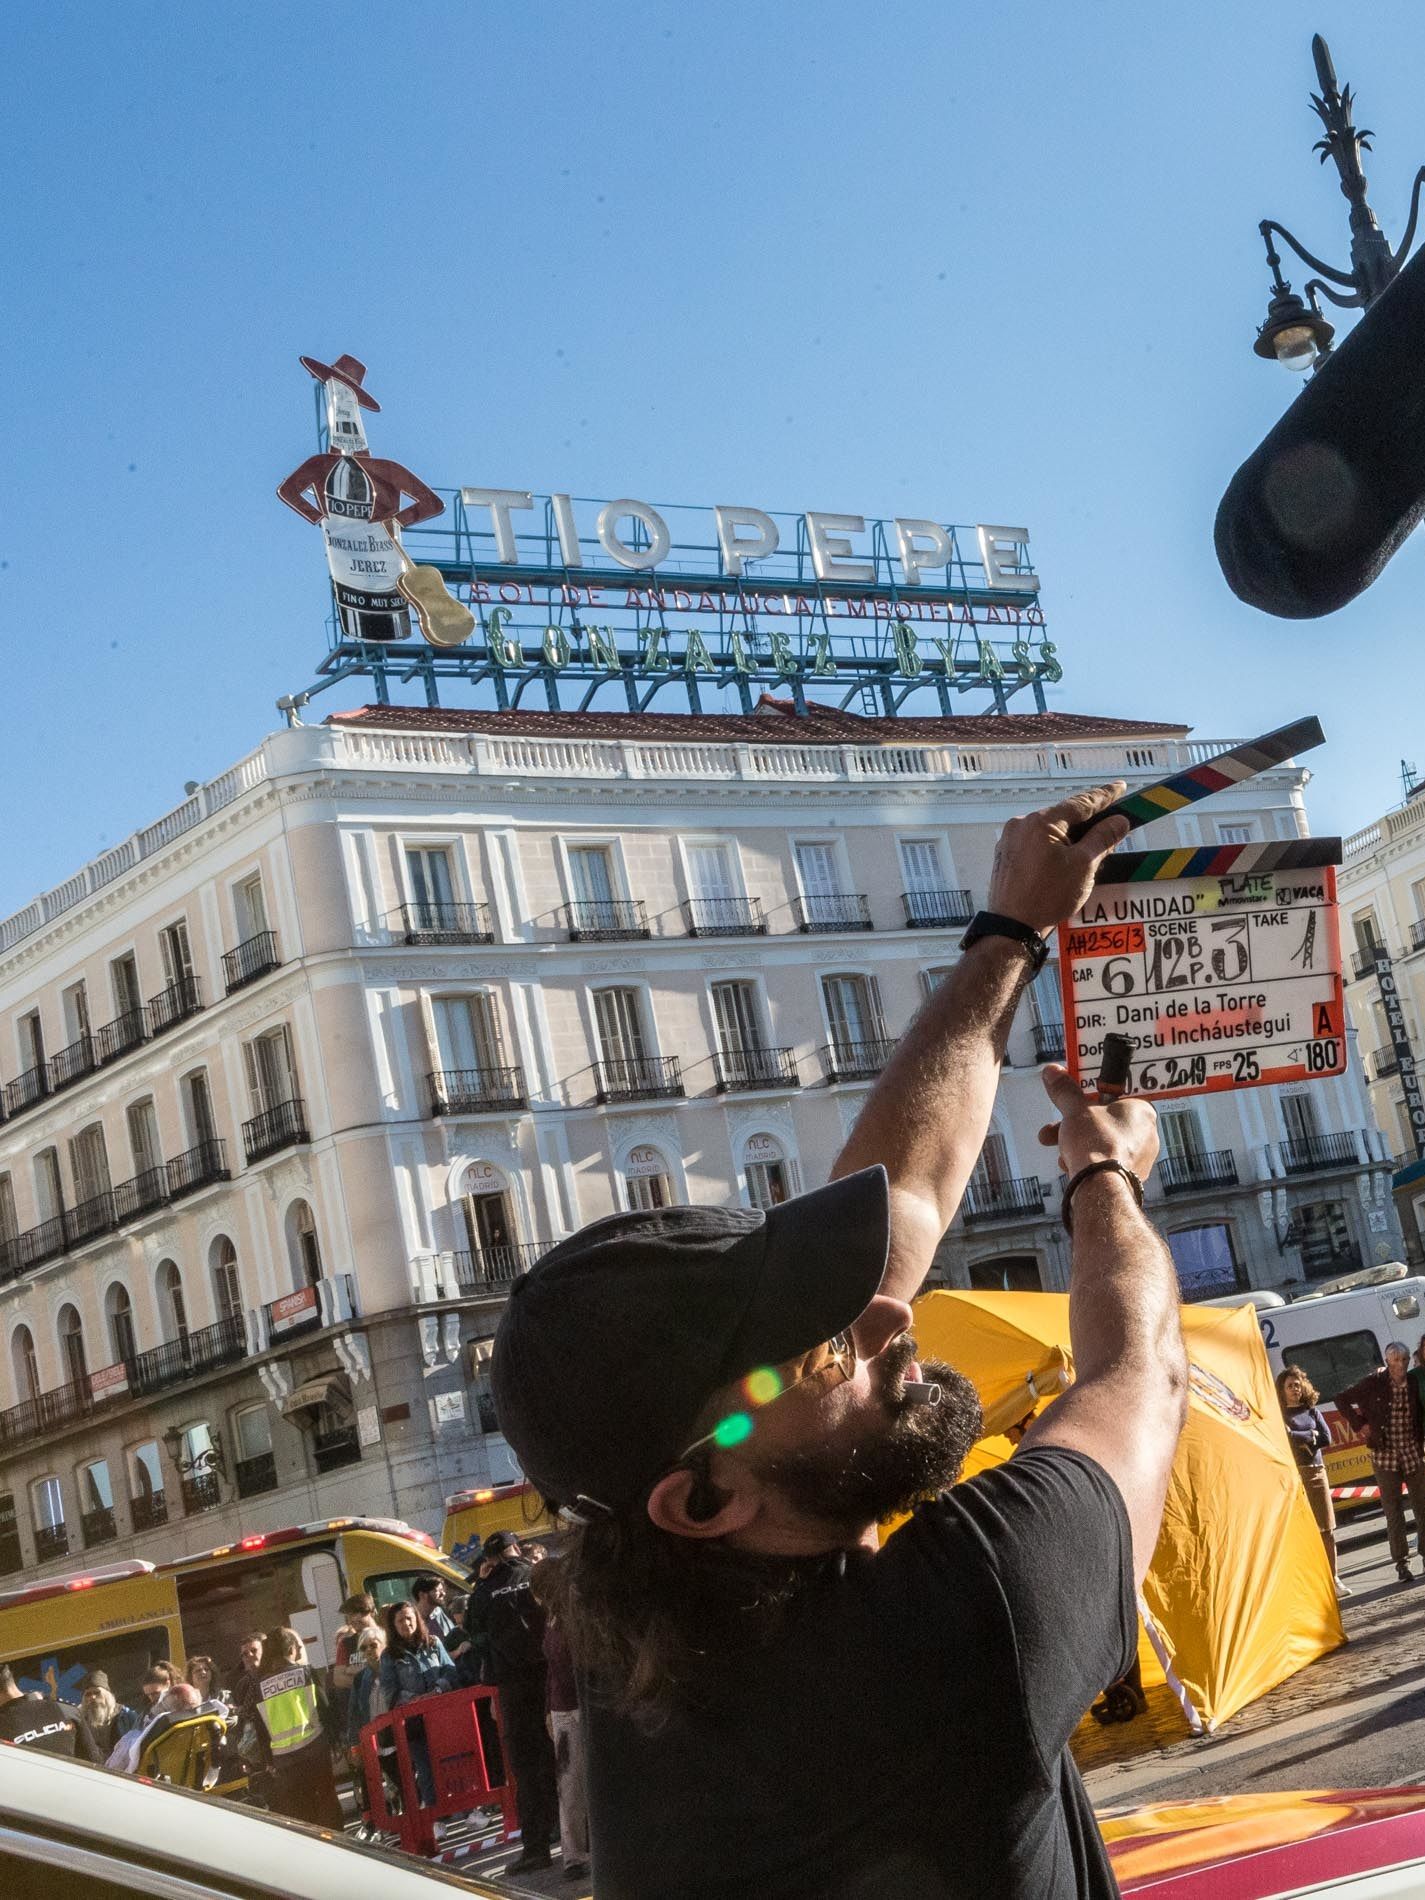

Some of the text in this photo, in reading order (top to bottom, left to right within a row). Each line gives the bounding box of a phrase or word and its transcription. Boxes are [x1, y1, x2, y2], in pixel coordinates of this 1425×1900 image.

[330, 499, 345, 513] IO
[461, 487, 1041, 592] TIO PEPE
[350, 559, 387, 574] JEREZ
[342, 592, 365, 606] FINO
[371, 598, 388, 608] MUY
[470, 582, 549, 605] SOL
[561, 584, 608, 607] DE
[488, 606, 1063, 683] GONZALEZ BYASS
[1218, 873, 1273, 894] PLATE
[1293, 886, 1325, 899] VACA
[1149, 921, 1198, 937] SCENE
[1252, 912, 1289, 927] TAKE
[1291, 910, 1316, 969] 1
[1101, 957, 1135, 995] 6
[1076, 993, 1267, 1029] DIR: Dani de la Torre
[1376, 959, 1408, 1043] HOTEL
[1129, 1033, 1164, 1050] osu
[1171, 1013, 1291, 1045] Incháustegui
[1317, 1006, 1332, 1034] A
[1213, 1050, 1260, 1082] FPS 25
[492, 1581, 530, 1598] POLICI
[264, 1676, 305, 1695] POLICIA
